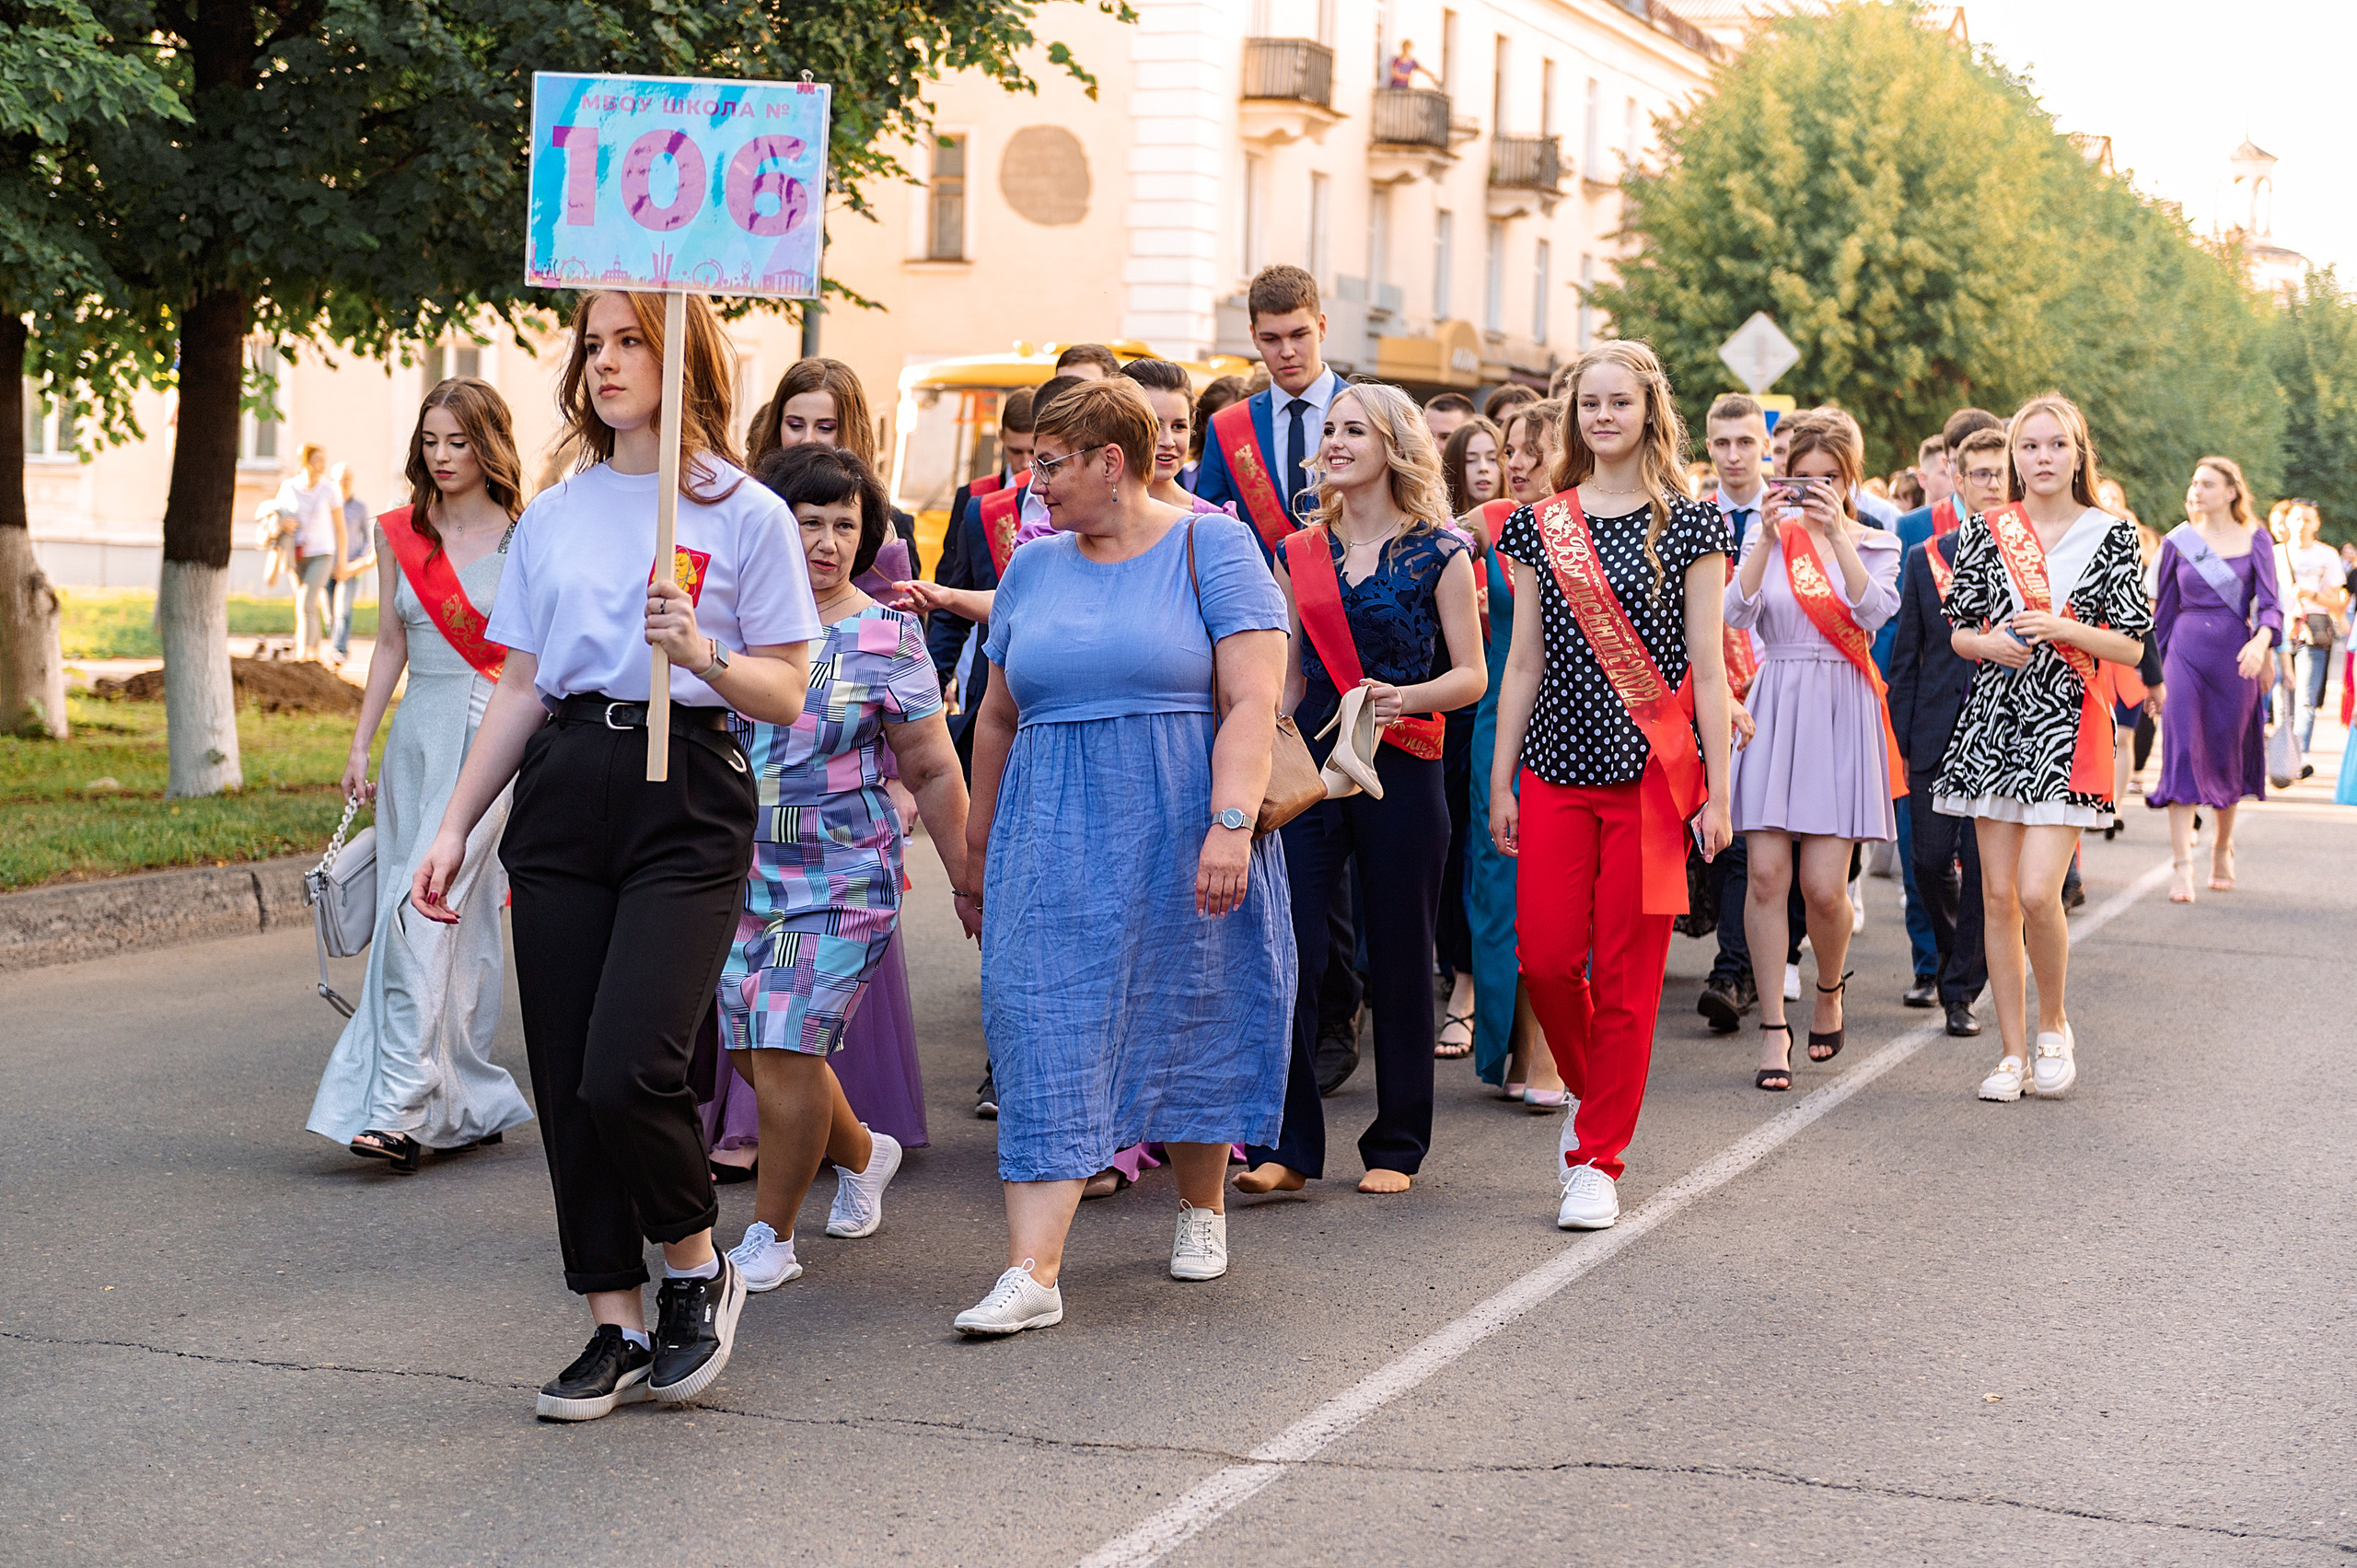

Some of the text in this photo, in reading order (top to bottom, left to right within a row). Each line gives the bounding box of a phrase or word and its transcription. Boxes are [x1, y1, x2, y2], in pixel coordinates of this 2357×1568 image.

[581, 94, 790, 119] МБОУ ШКОЛА №
[552, 125, 808, 237] 106
[1552, 537, 1663, 709] Выпускник 2022
